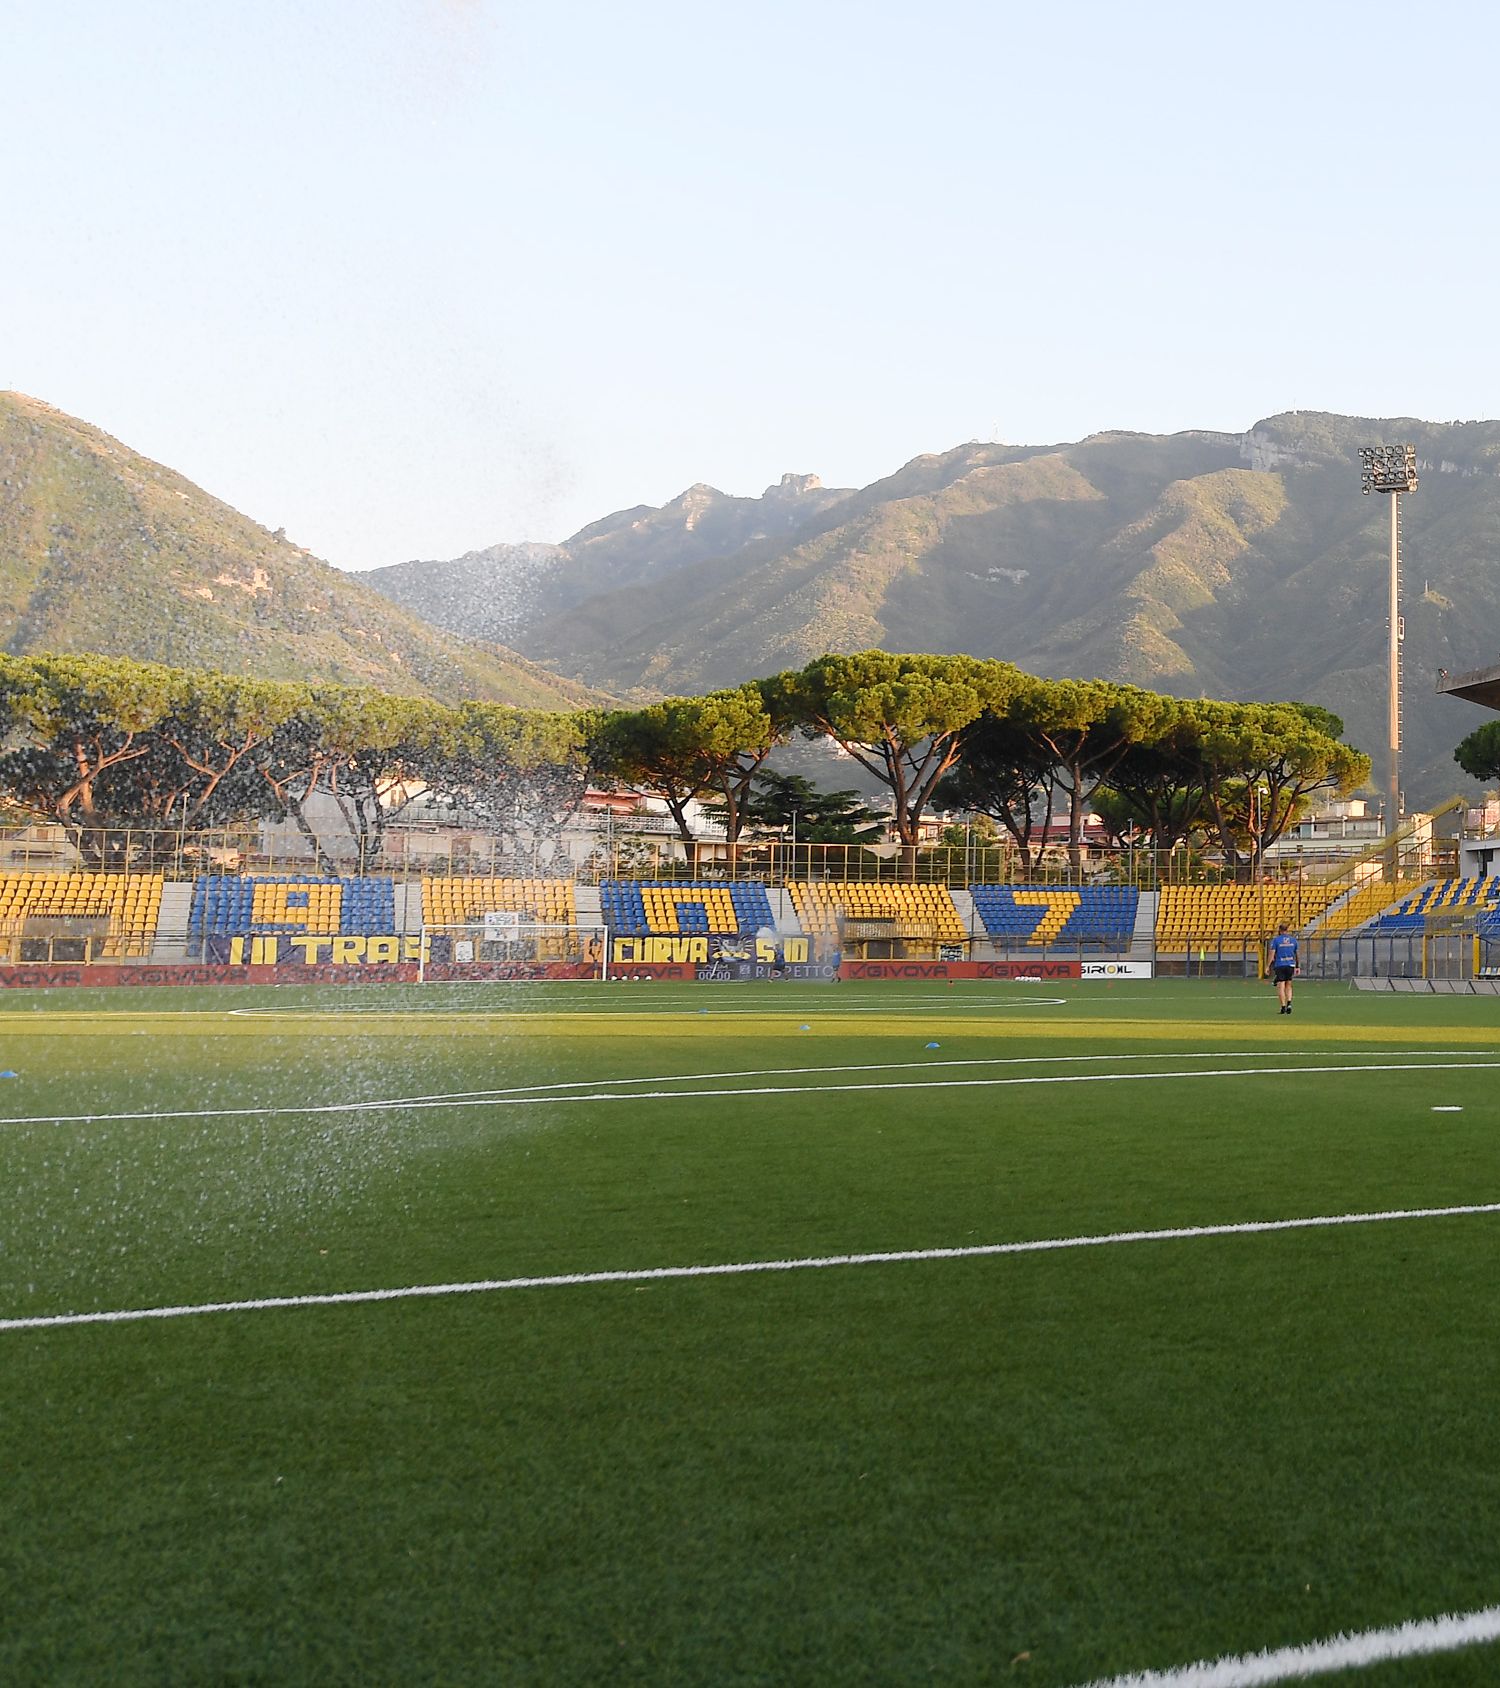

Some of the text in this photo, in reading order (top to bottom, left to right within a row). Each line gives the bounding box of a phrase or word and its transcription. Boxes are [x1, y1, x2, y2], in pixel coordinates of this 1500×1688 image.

[613, 937, 708, 963] CURVA
[866, 965, 949, 978] GIVOVA
[993, 965, 1071, 977] GIVOVA
